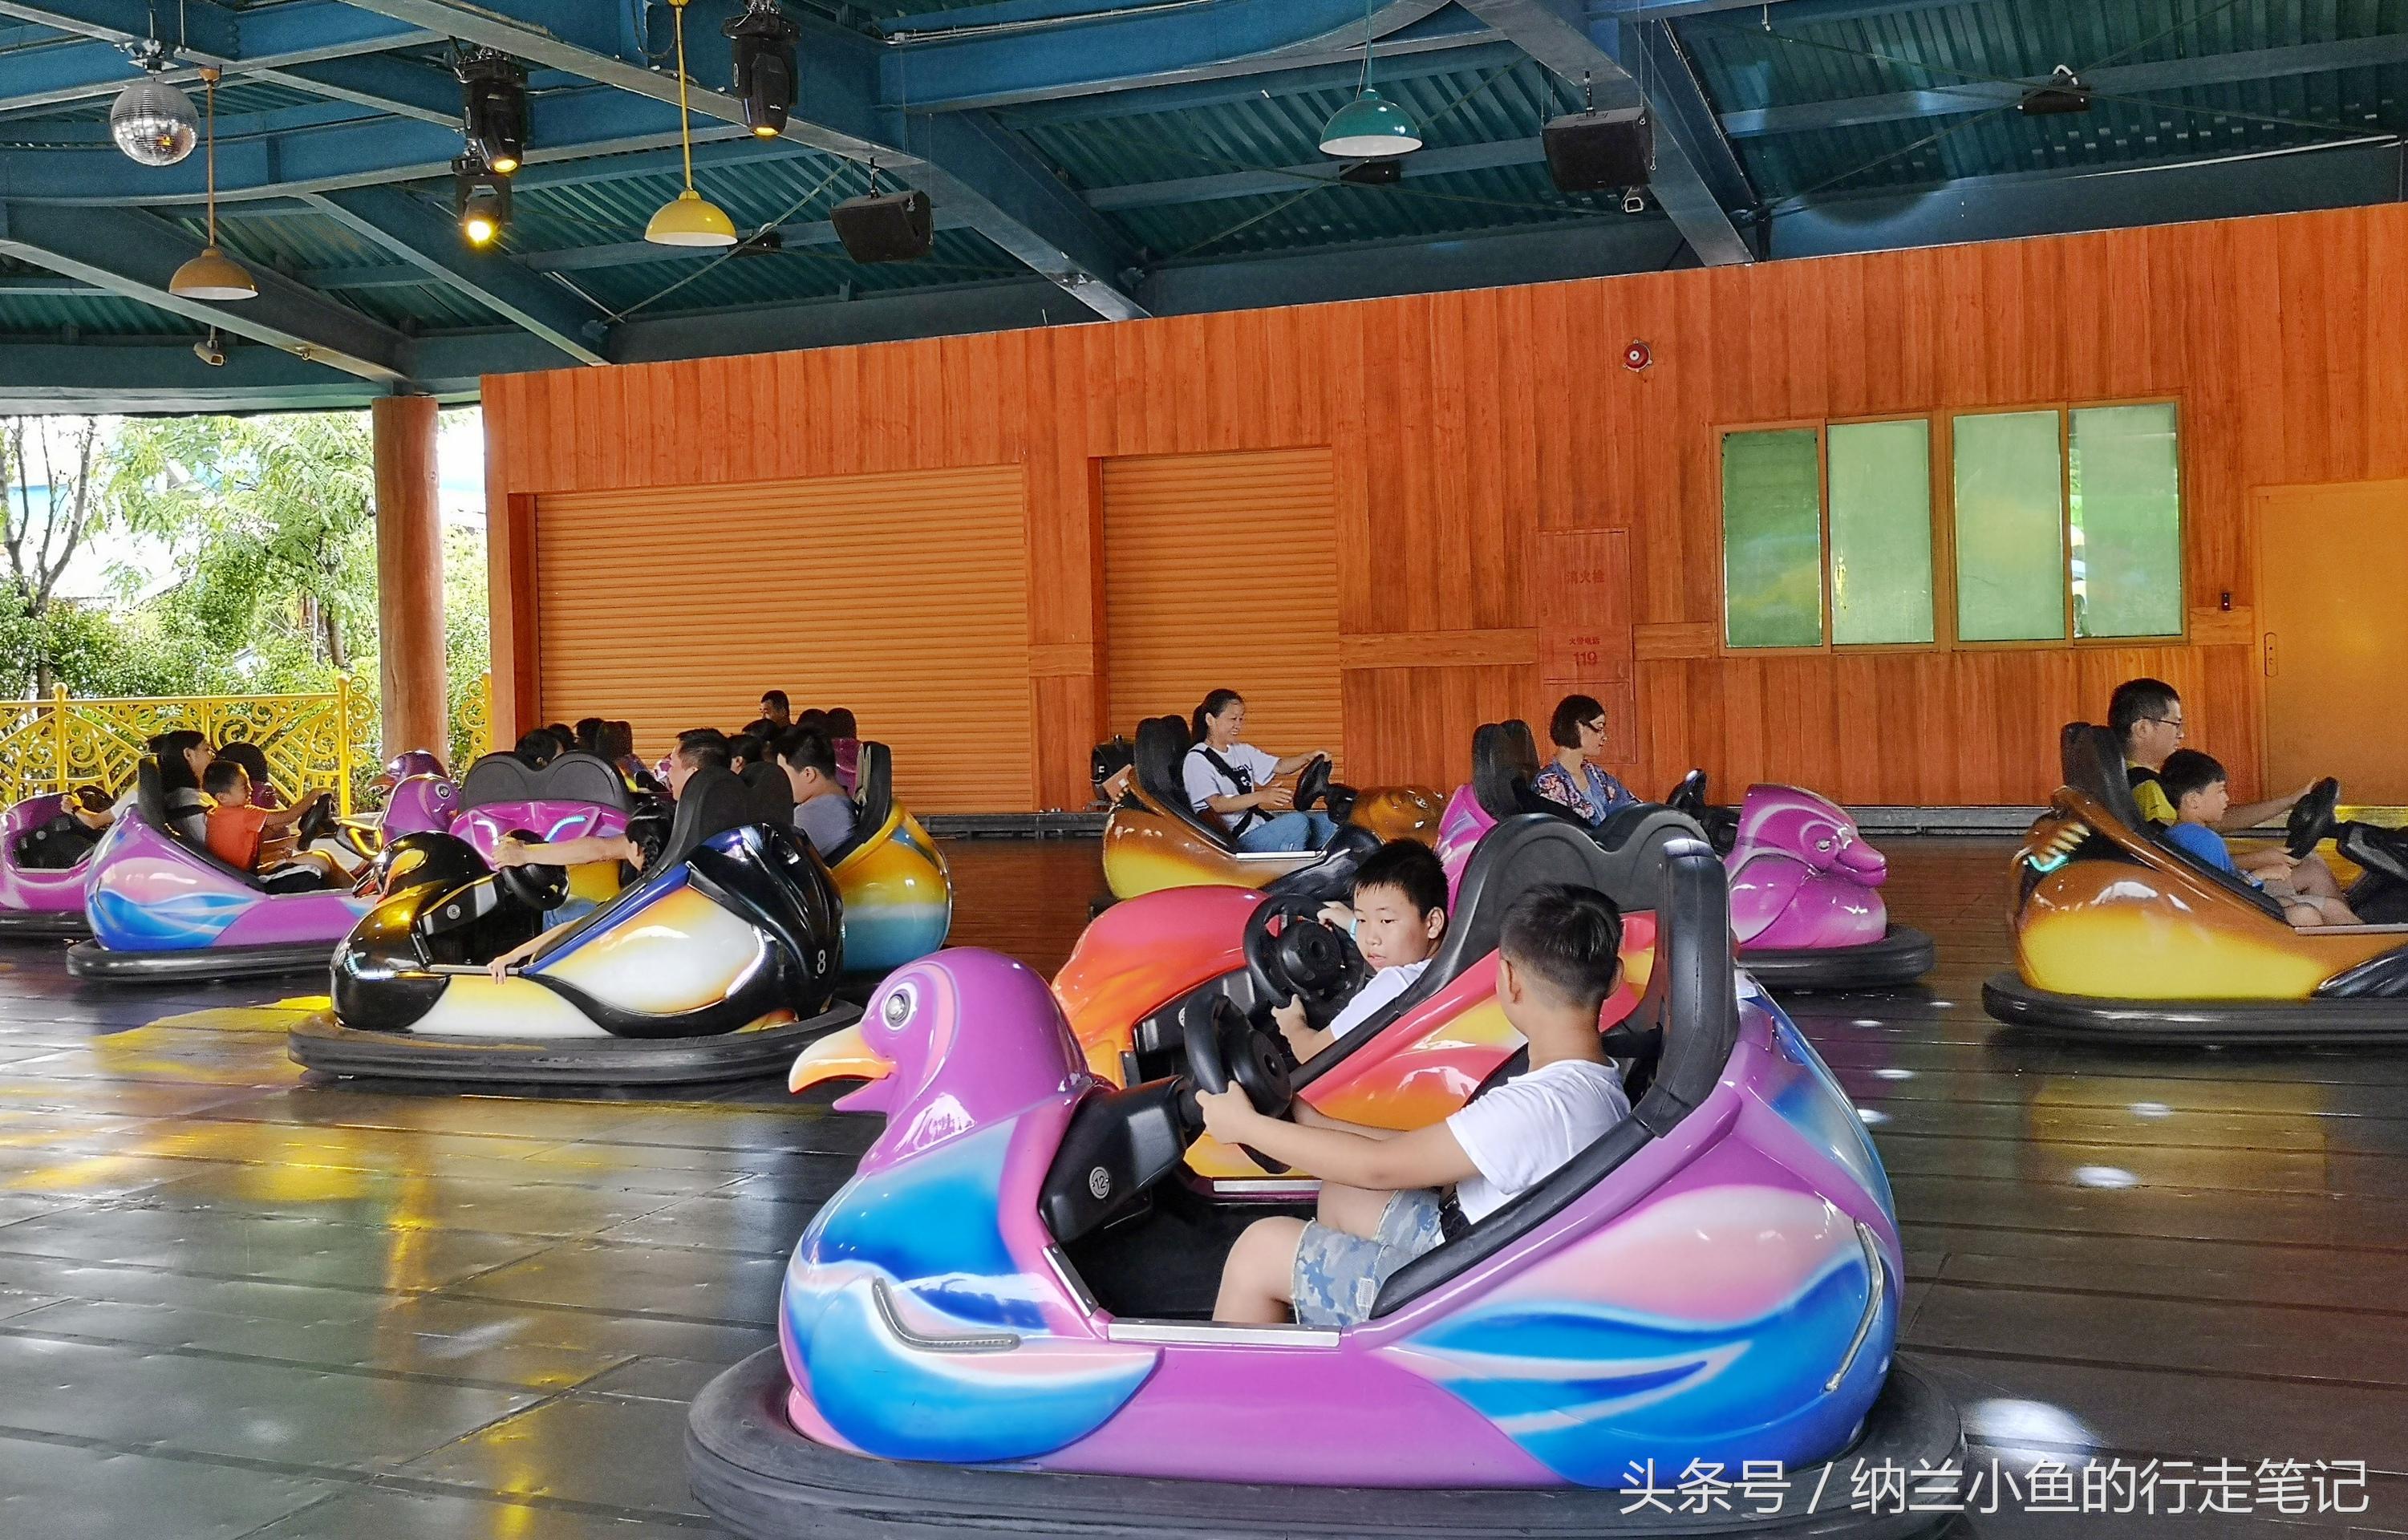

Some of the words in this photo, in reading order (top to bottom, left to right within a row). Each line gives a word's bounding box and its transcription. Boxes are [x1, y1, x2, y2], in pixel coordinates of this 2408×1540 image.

[1573, 651, 1598, 667] 119
[817, 949, 826, 975] 8
[1094, 1175, 1106, 1190] 12
